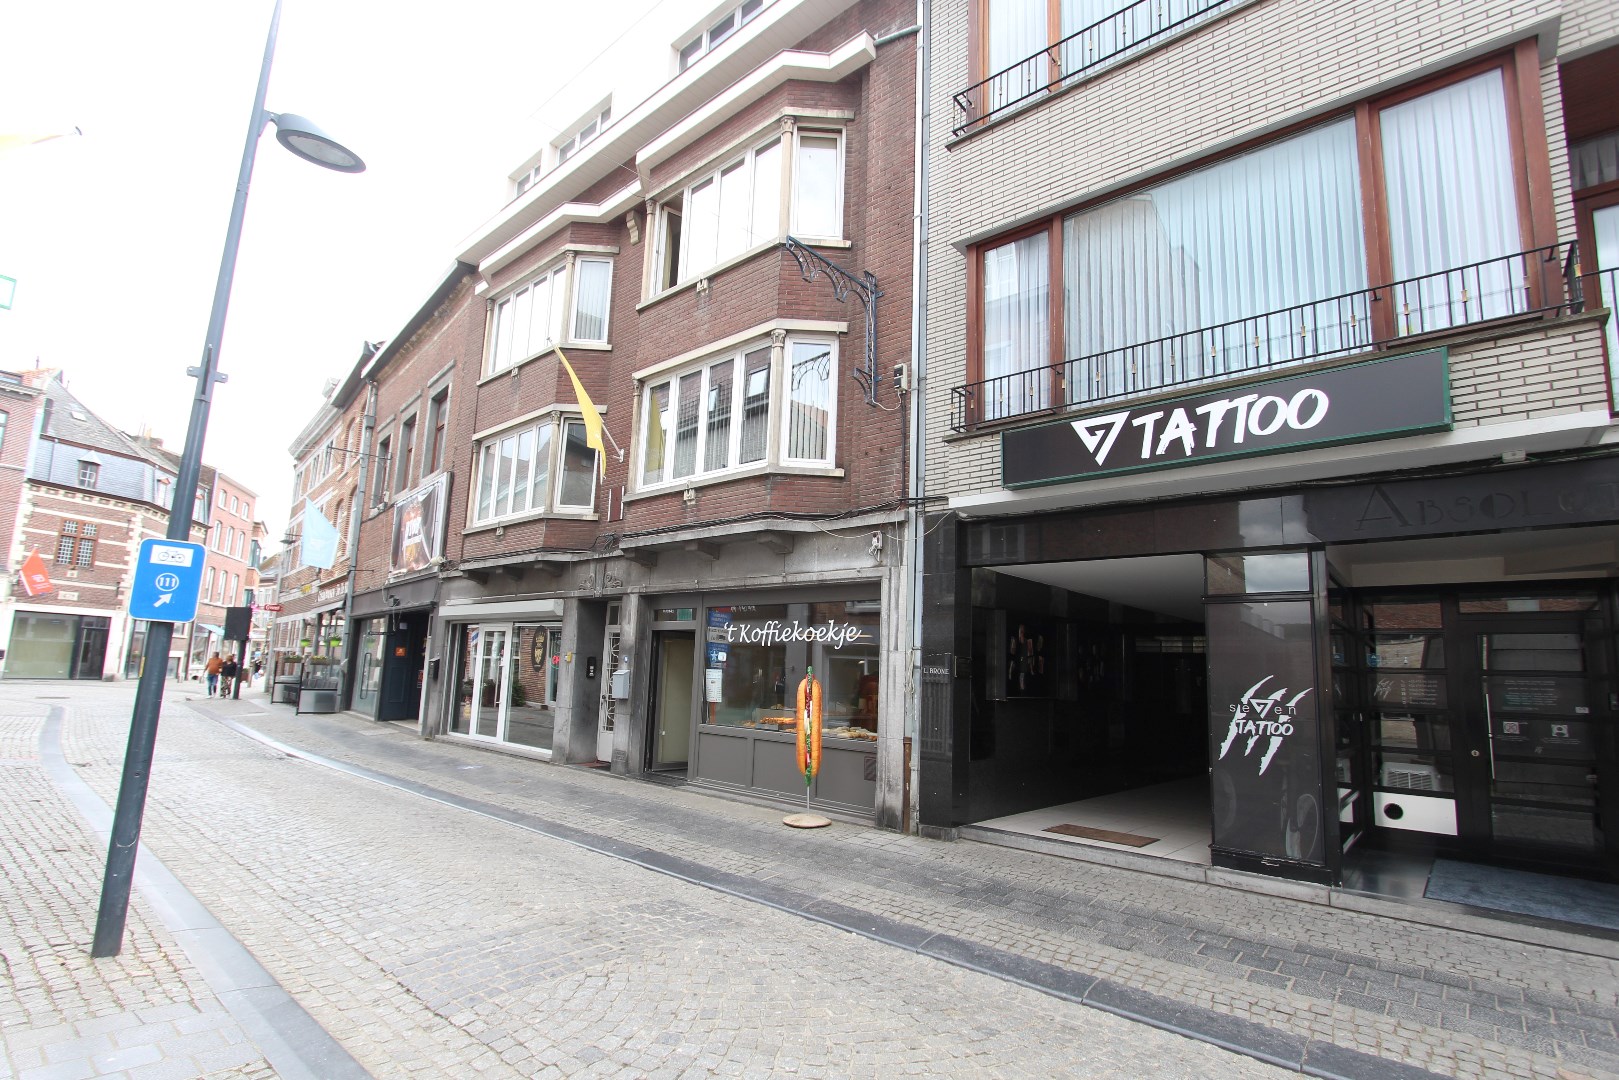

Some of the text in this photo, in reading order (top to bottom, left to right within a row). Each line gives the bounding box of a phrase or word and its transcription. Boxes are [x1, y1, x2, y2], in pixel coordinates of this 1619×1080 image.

[1131, 388, 1329, 459] TATTOO
[159, 577, 176, 588] 111
[739, 619, 862, 650] Koffiekoekje
[1235, 719, 1294, 736] TATTOO
